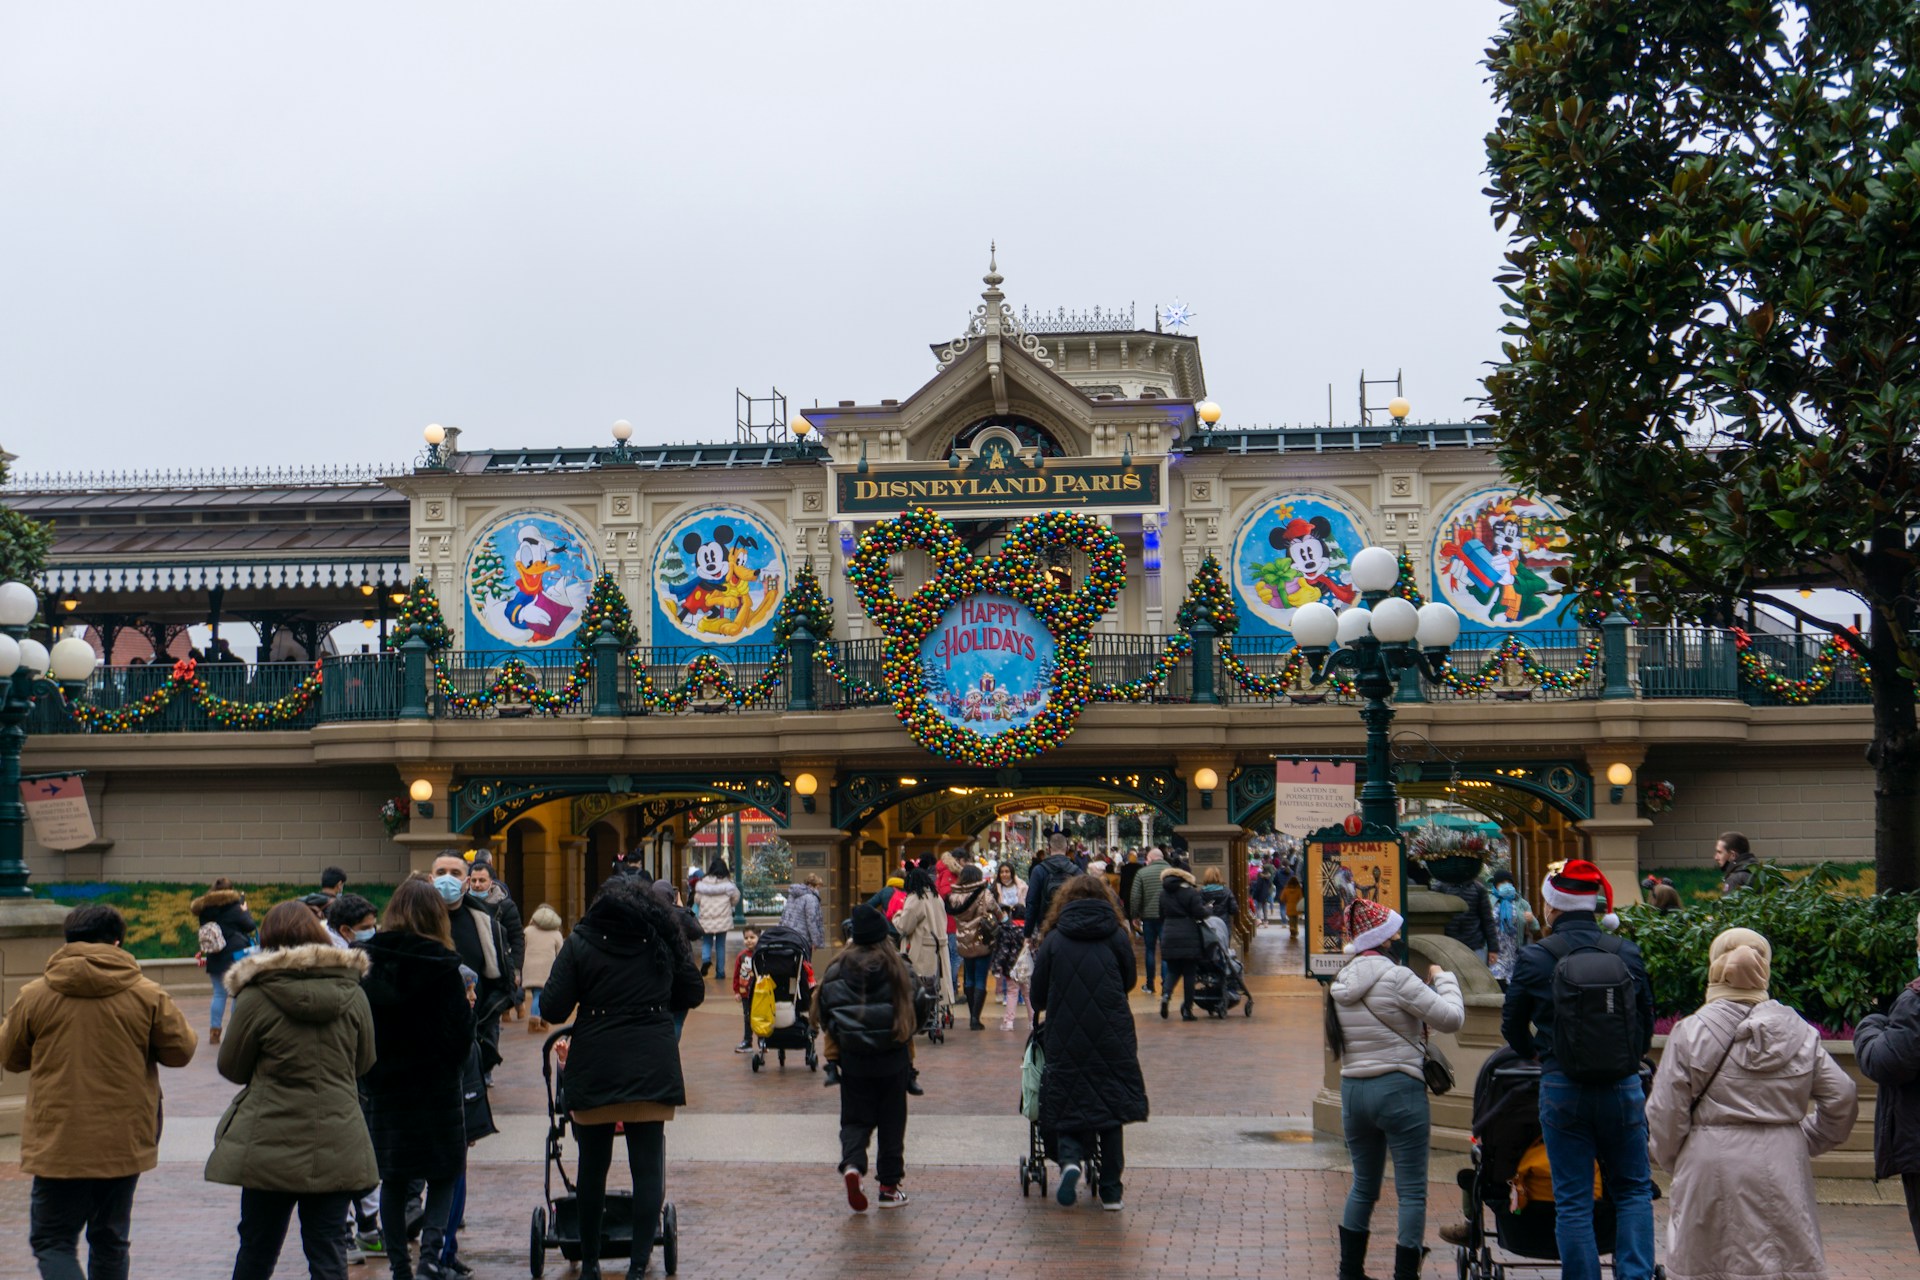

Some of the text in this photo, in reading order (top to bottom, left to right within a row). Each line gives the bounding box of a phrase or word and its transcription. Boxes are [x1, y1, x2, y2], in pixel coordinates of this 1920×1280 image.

[854, 473, 1142, 499] DISNEYLAND PARIS
[961, 599, 1020, 626] HAPPY
[934, 625, 1036, 671] HOLIDAYS
[1286, 793, 1323, 801] POUSSETTES
[1315, 801, 1352, 809] ROULANTS
